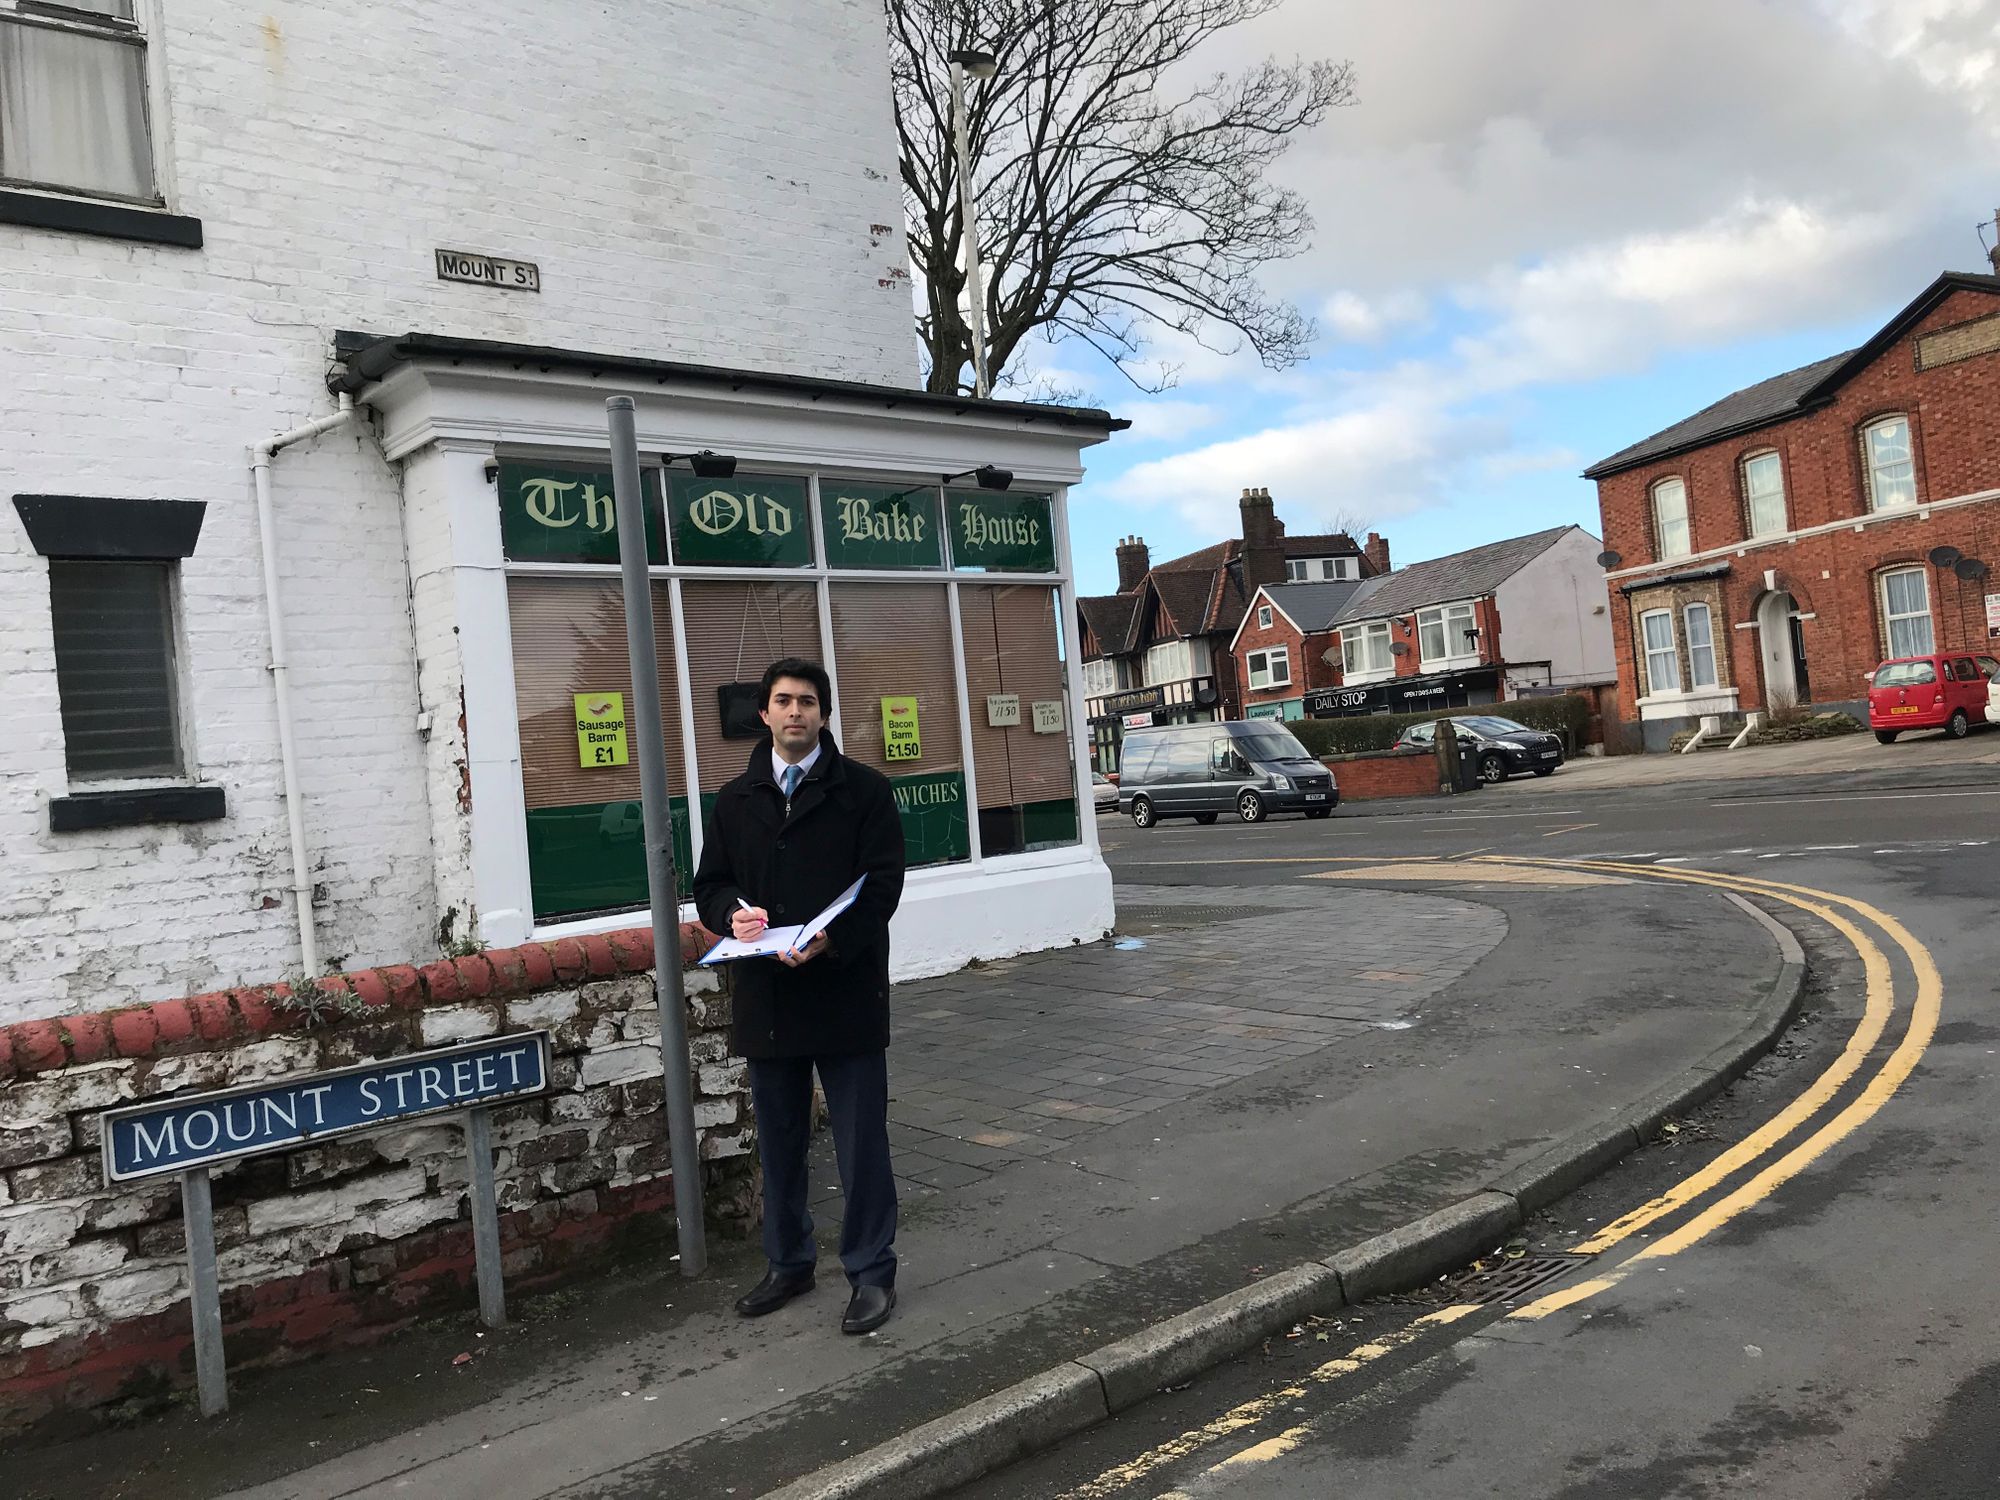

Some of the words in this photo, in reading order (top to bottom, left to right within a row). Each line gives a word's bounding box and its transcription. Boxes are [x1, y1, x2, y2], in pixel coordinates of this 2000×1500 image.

[442, 255, 507, 281] MOUNT
[520, 477, 616, 534] Th
[689, 490, 793, 537] Old
[836, 496, 926, 546] Bake
[959, 503, 1041, 551] House
[1315, 695, 1340, 710] DAILY
[1341, 691, 1367, 707] STOP
[578, 720, 624, 731] Sausage
[888, 720, 914, 729] Bacon
[588, 733, 617, 743] Barm
[891, 731, 913, 740] Barm
[595, 746, 614, 763] £1
[887, 742, 919, 758] £1.50
[131, 1084, 333, 1164] MOUNT
[360, 1047, 528, 1116] STREET
